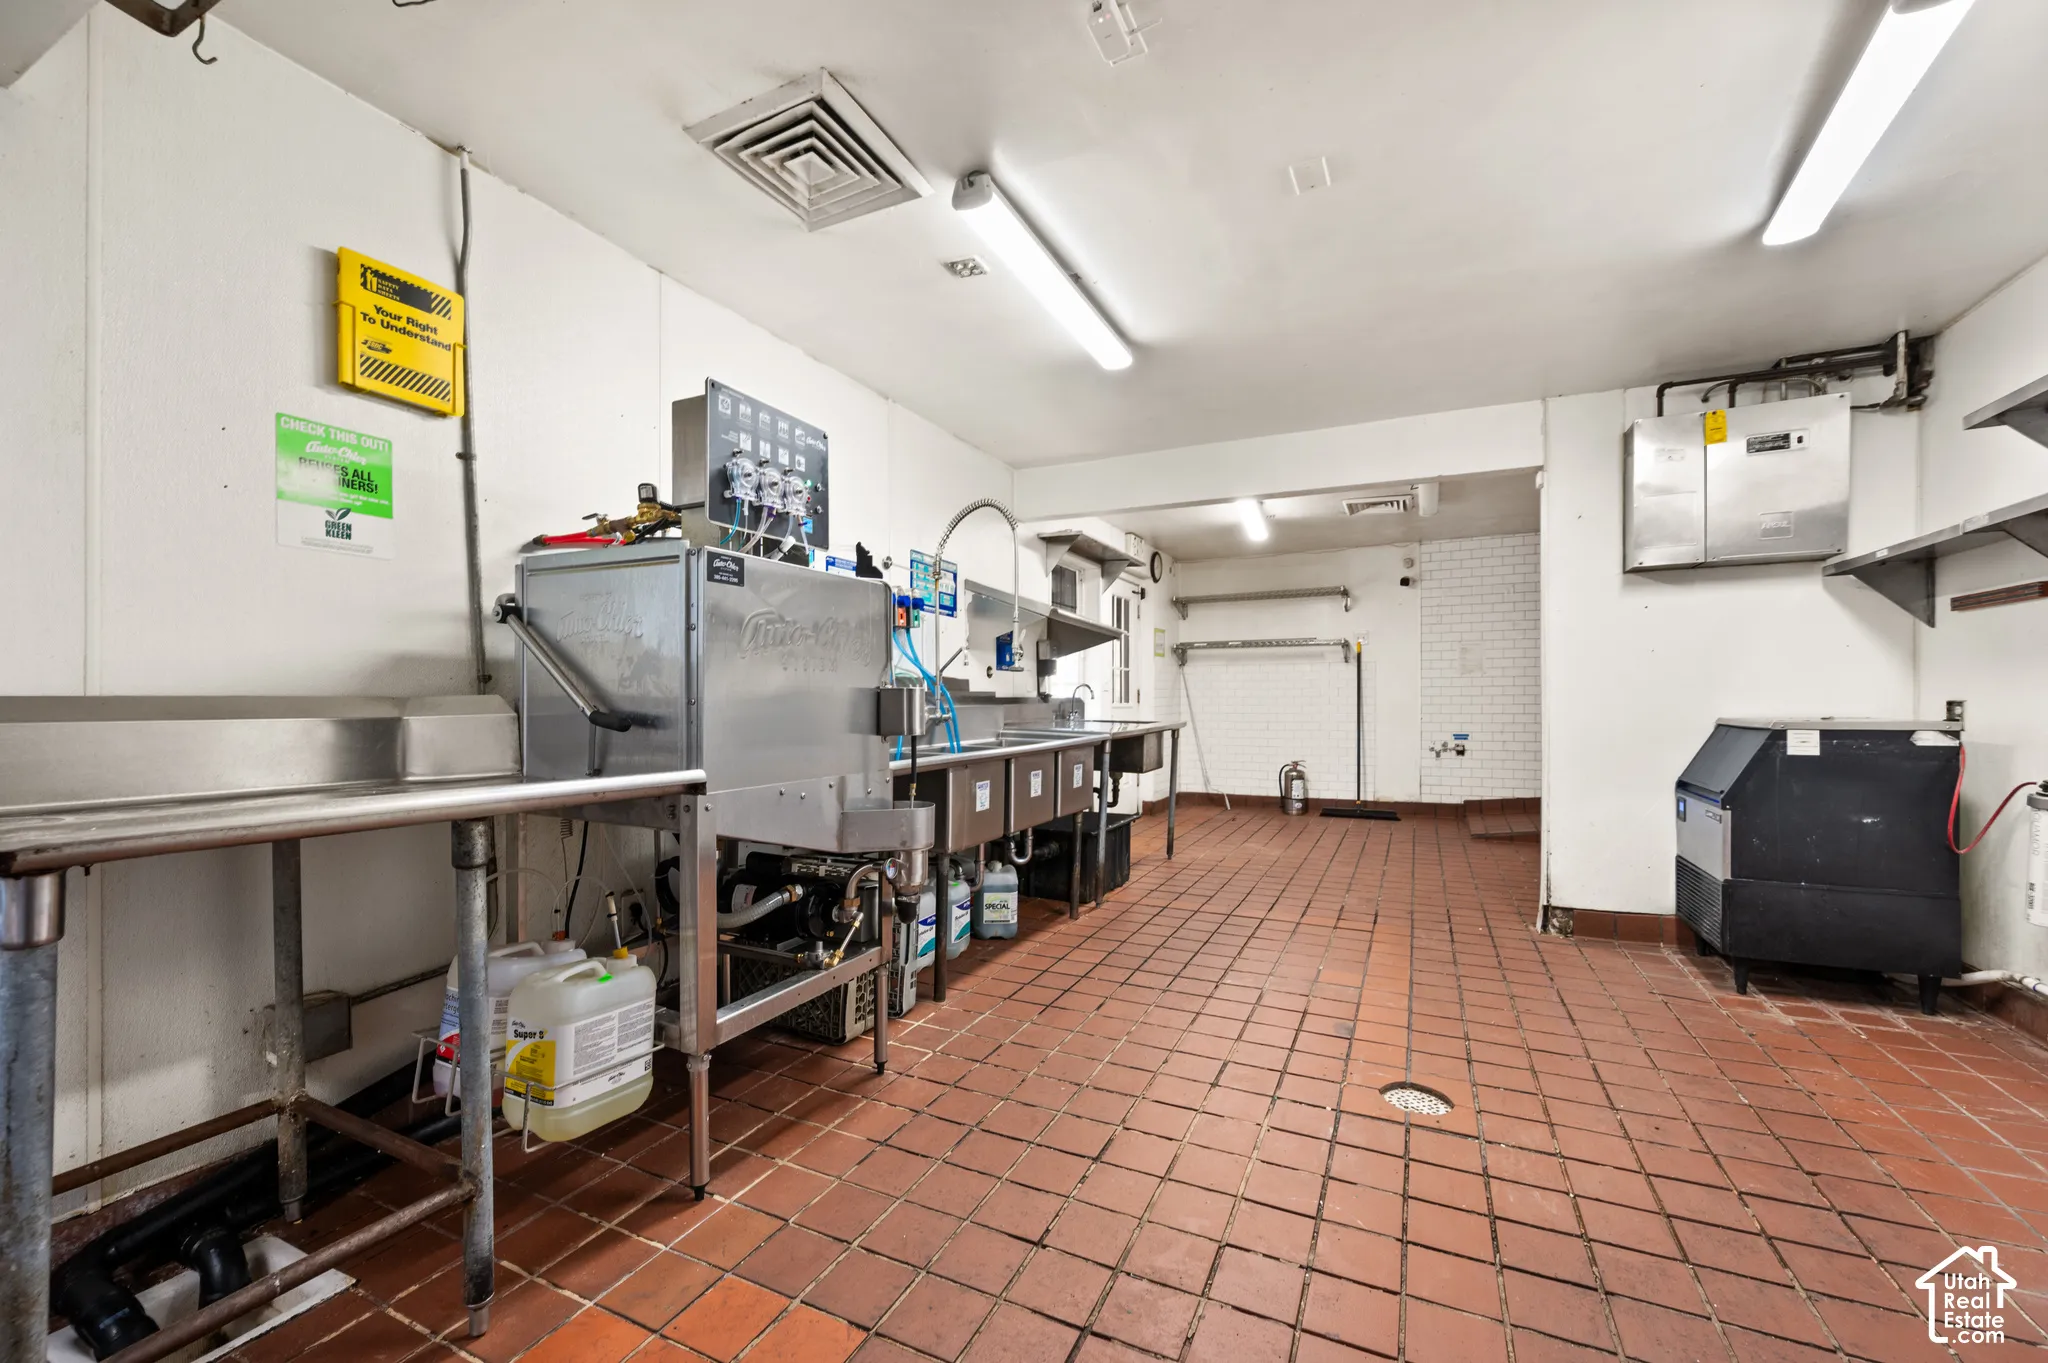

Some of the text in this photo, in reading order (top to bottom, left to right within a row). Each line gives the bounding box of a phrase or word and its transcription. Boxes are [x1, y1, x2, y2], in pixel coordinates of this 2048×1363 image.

[378, 278, 400, 290] SAFETY
[378, 284, 393, 294] DATA
[373, 304, 438, 335] Your Right
[360, 312, 376, 325] To
[380, 320, 451, 352] Understand
[280, 416, 389, 453] CHECK THIS OUT!
[352, 468, 375, 483] ALL
[325, 520, 352, 532] GREEN
[325, 529, 352, 540] KLEEN
[513, 1029, 545, 1040] Super 8
